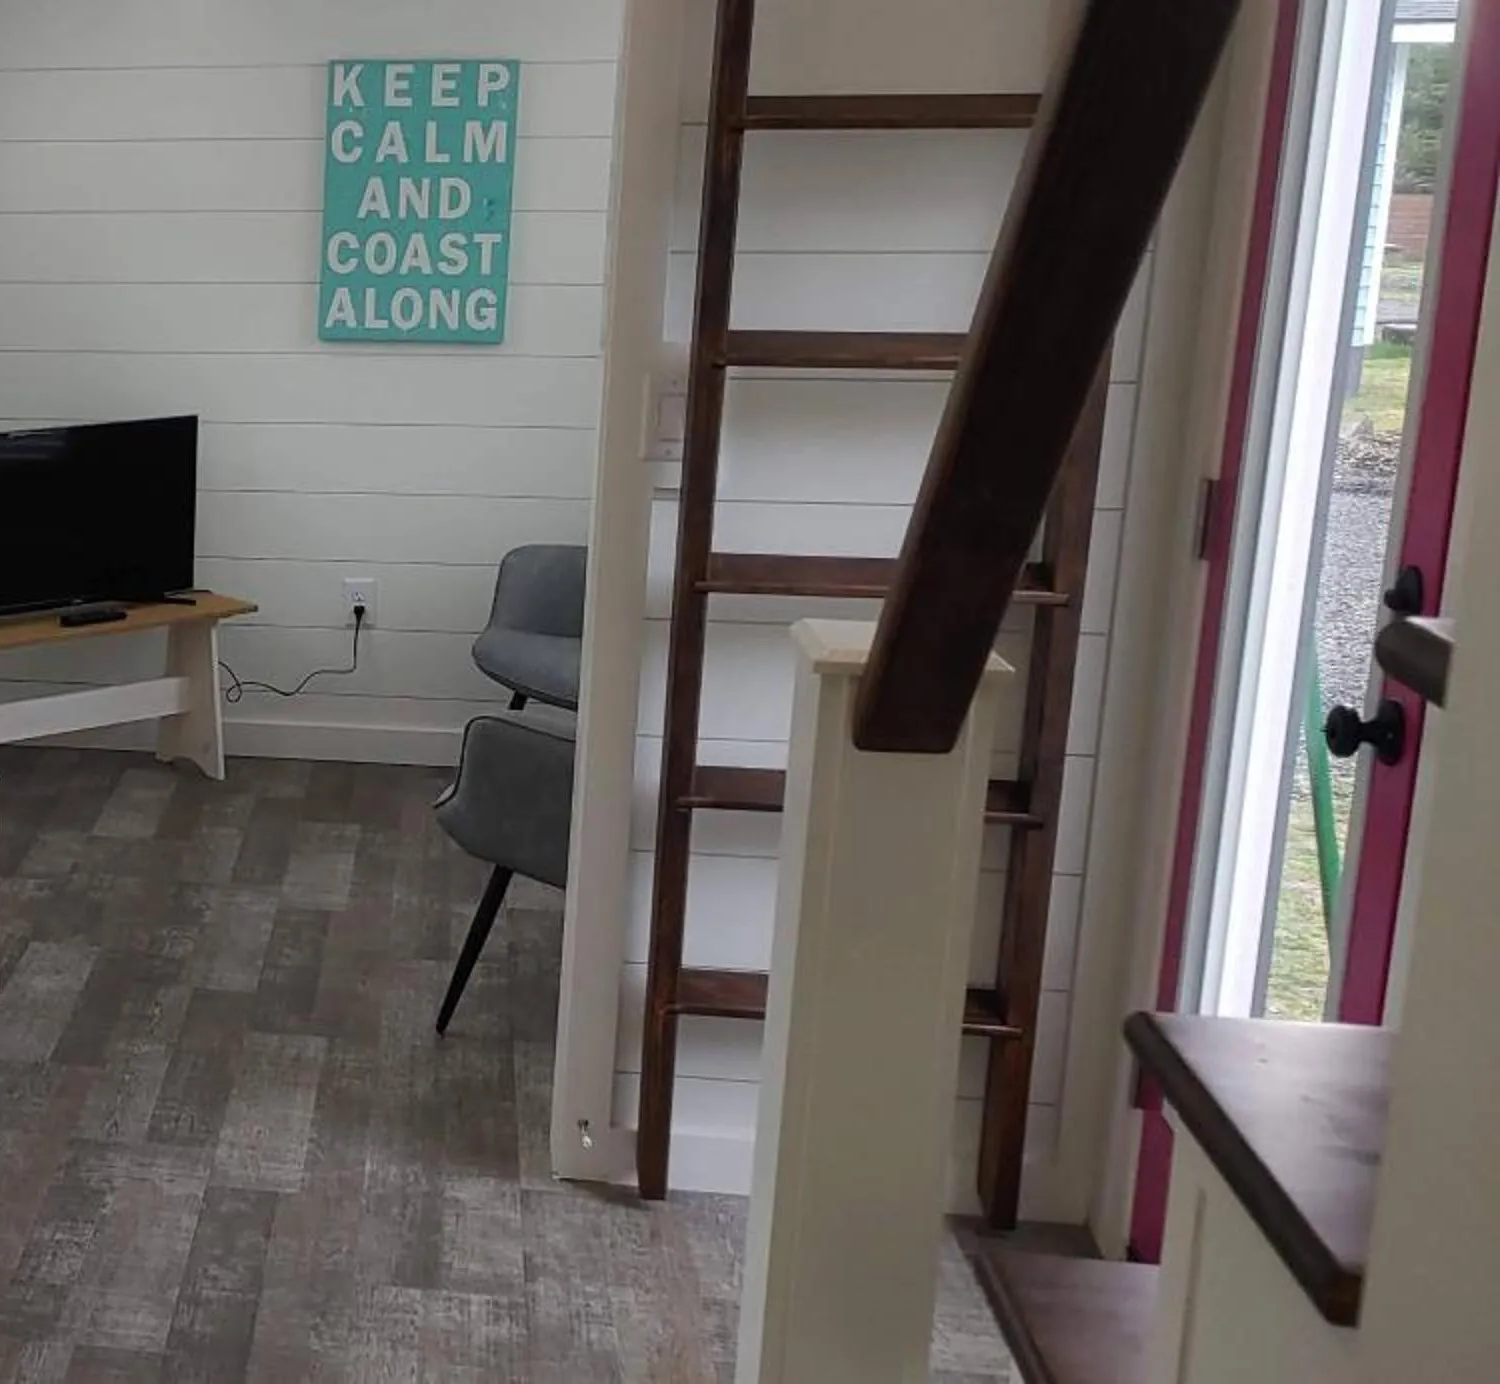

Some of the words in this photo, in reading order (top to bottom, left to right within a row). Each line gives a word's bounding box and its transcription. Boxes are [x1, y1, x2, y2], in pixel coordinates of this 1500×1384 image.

[333, 63, 510, 107] KEEP
[331, 120, 508, 163] CALM
[357, 176, 472, 219] AND
[327, 231, 502, 275] COAST
[324, 287, 498, 331] ALONG
